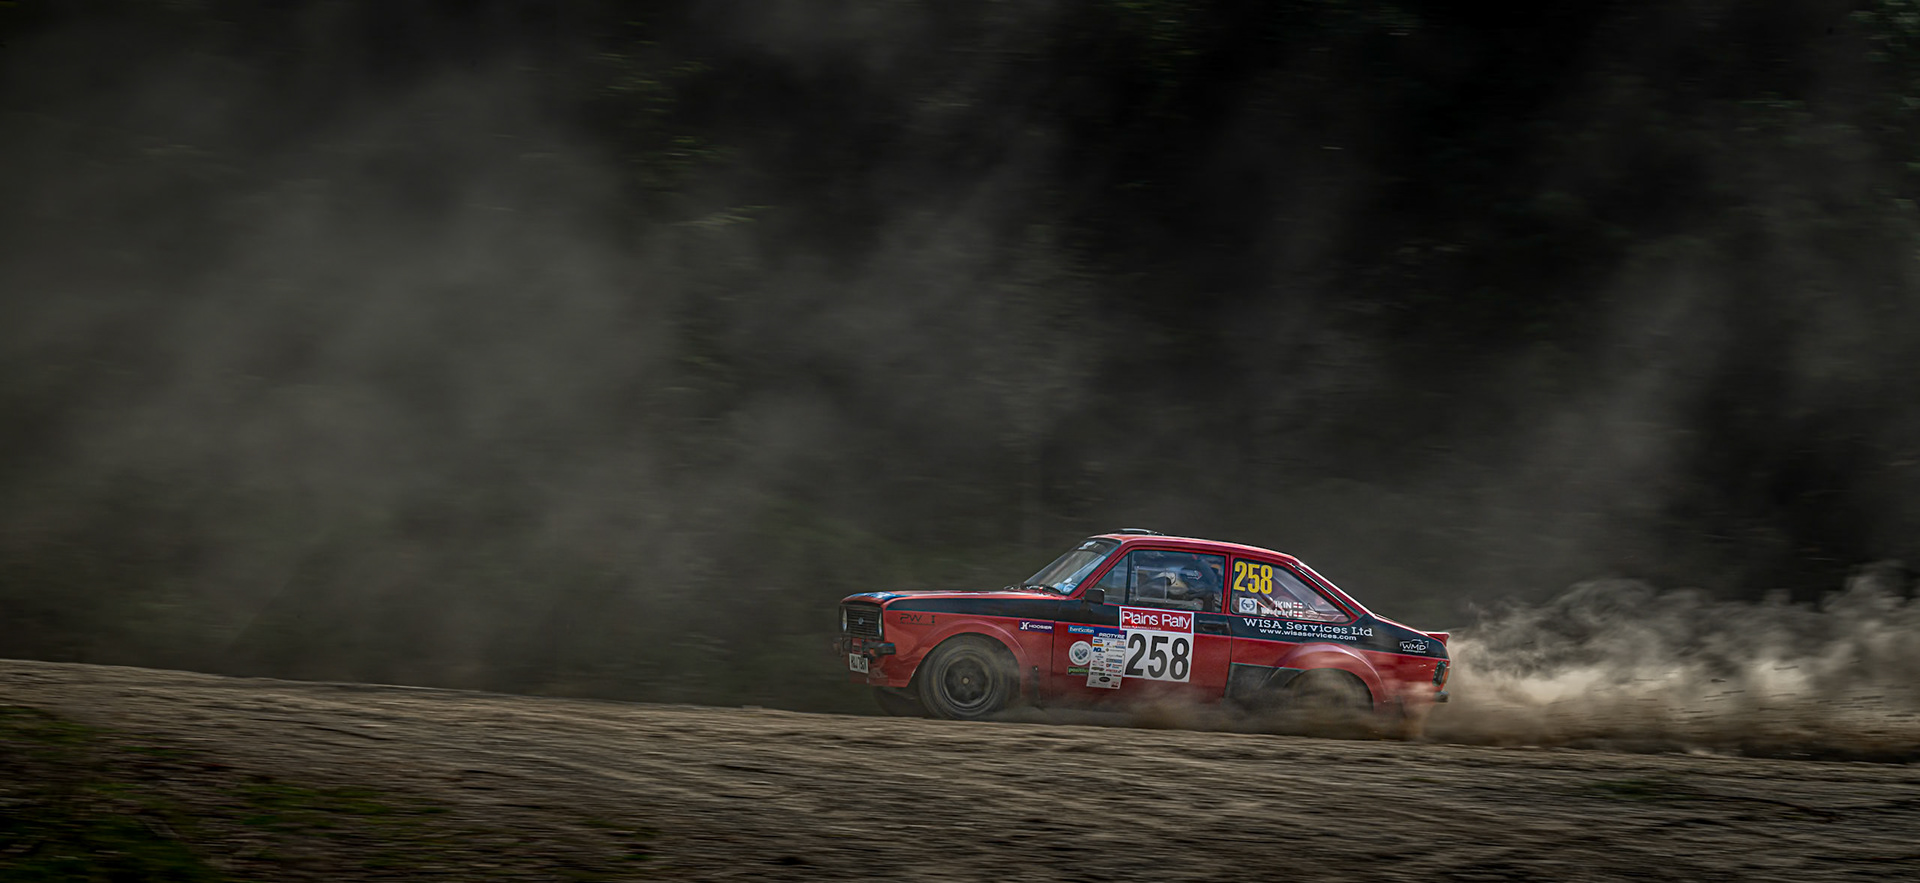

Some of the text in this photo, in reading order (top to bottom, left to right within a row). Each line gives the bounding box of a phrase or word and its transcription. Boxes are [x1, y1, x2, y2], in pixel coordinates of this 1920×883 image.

[1233, 561, 1273, 594] 258
[1122, 611, 1191, 629] Plains Rally
[1243, 618, 1373, 637] WISA Services Ltd
[1260, 628, 1357, 640] www.wisaservices.com
[1124, 633, 1190, 680] 258
